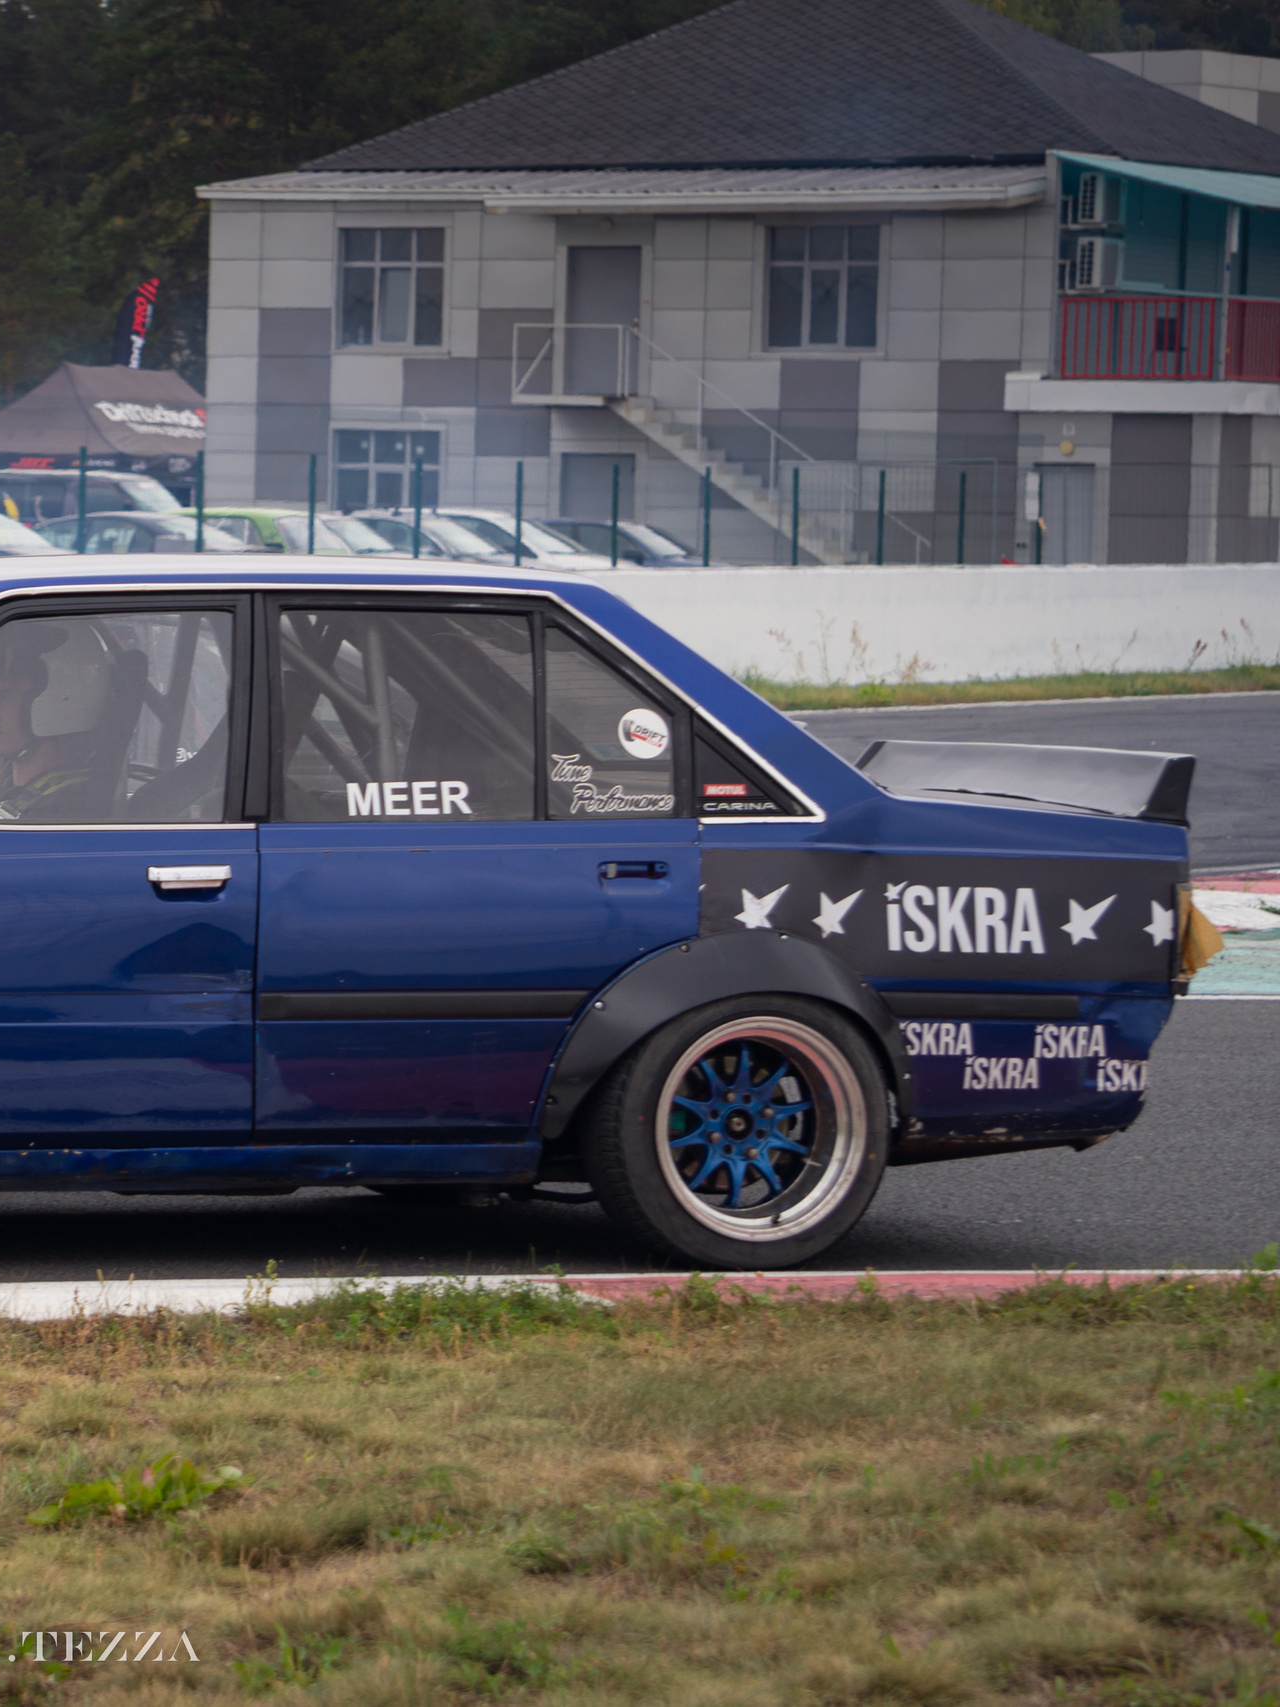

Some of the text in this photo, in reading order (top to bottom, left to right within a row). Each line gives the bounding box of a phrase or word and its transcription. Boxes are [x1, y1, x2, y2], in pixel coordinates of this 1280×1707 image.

[633, 725, 666, 742] DRIFT
[705, 785, 746, 795] MOTUL
[346, 781, 472, 816] MEER
[703, 802, 780, 811] CARINA
